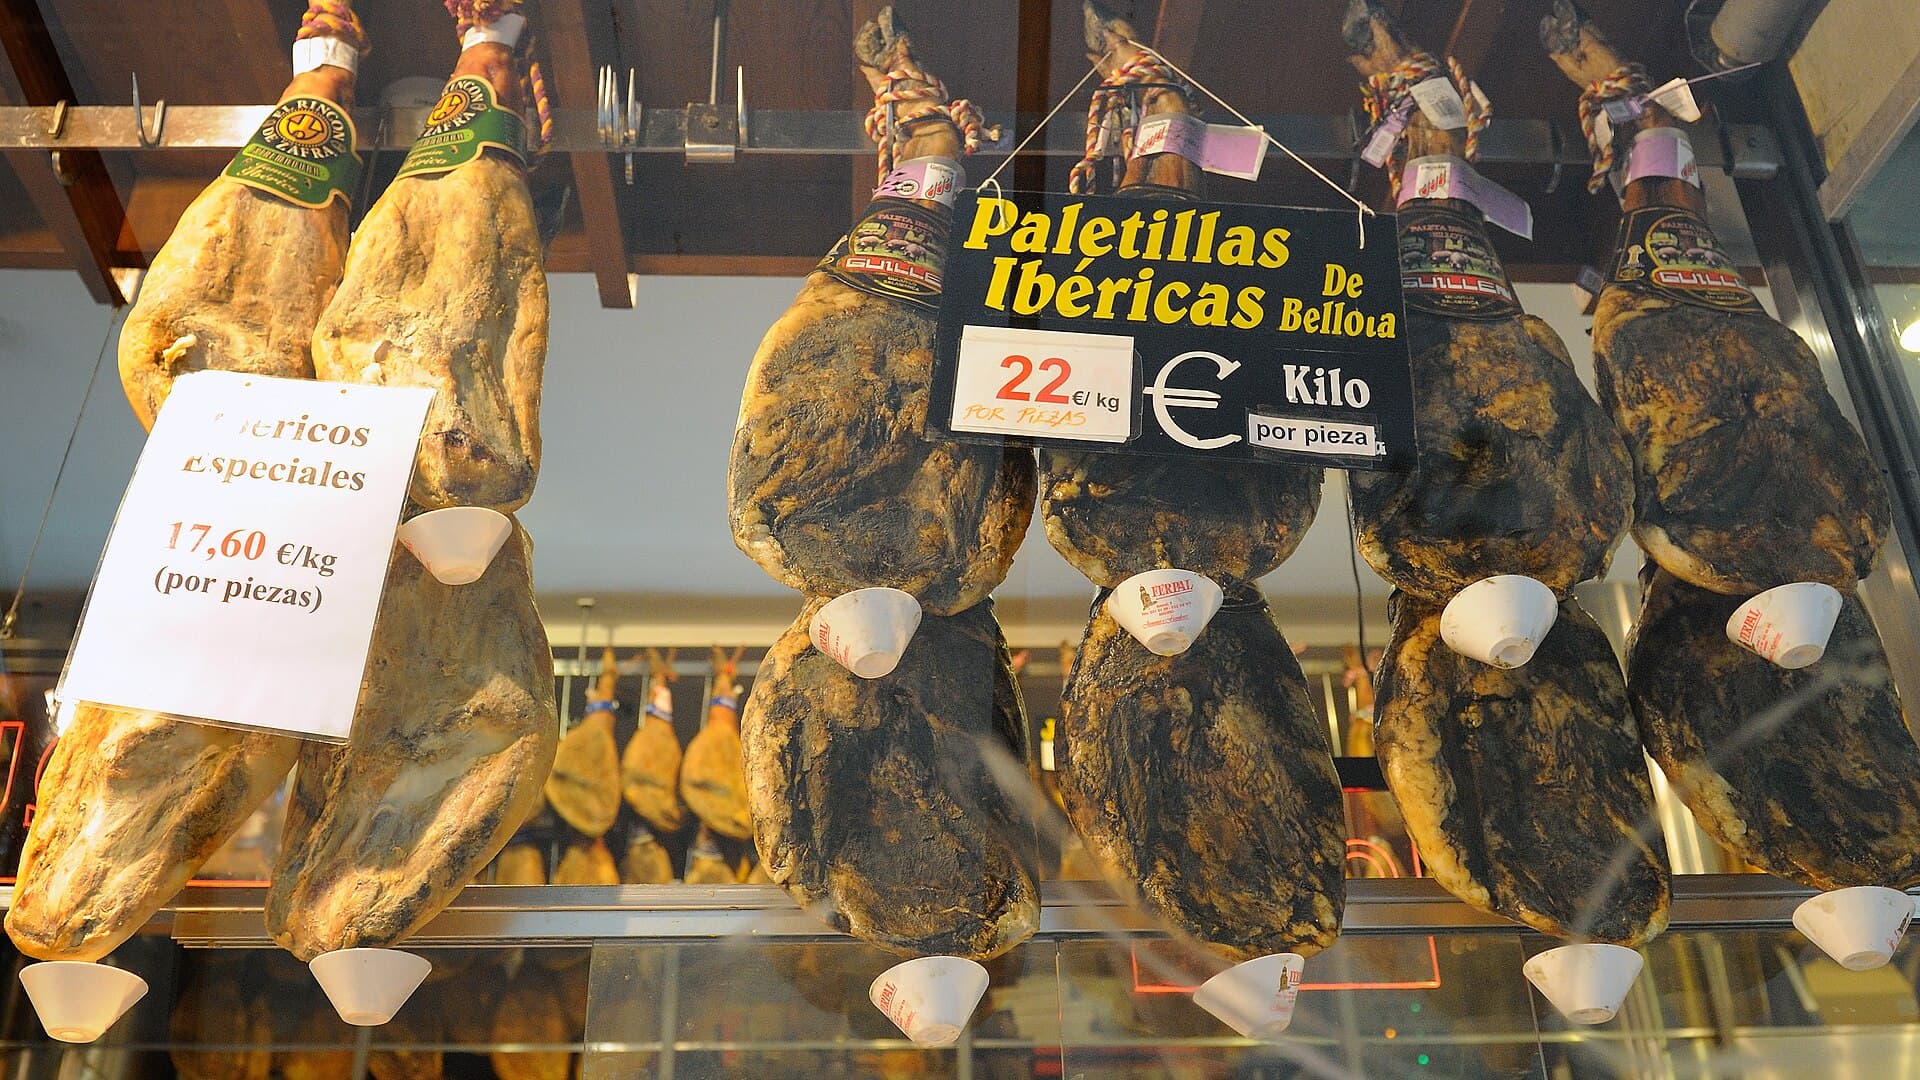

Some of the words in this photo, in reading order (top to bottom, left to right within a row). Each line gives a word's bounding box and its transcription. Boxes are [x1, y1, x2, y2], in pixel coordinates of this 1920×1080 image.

[271, 104, 294, 119] EL
[297, 100, 346, 142] RINCON
[423, 112, 476, 137] ZAFRA
[262, 128, 279, 143] DE
[275, 142, 335, 159] ZAFRA
[962, 197, 1292, 269] Paletillas
[846, 258, 942, 288] GUILLE
[1322, 263, 1364, 298] De
[1659, 272, 1745, 290] GUILL
[984, 256, 1266, 329] Ibéricas
[1279, 297, 1396, 339] Bellota
[996, 355, 1071, 404] 22
[1096, 392, 1120, 412] kg
[1283, 364, 1371, 409] Kilo
[213, 413, 370, 447] ericos
[962, 404, 1005, 421] POR
[1257, 423, 1297, 441] por
[1305, 425, 1368, 446] pieza
[183, 452, 366, 491] Especiales
[162, 521, 266, 561] 17,60
[276, 542, 338, 577] €/kg
[154, 565, 217, 595] (por
[221, 576, 323, 614] piezas)
[1151, 579, 1194, 598] FERPAL
